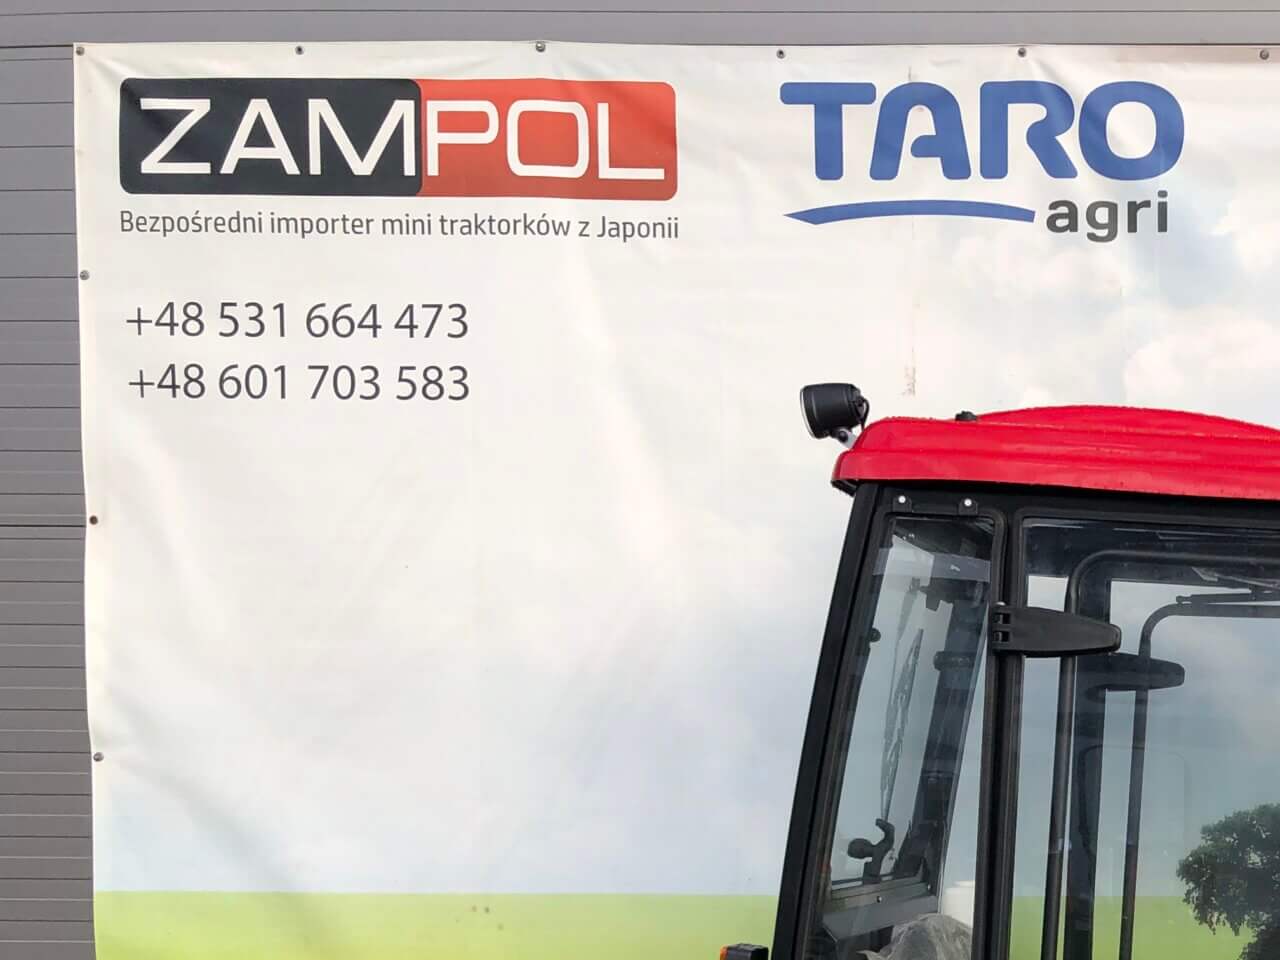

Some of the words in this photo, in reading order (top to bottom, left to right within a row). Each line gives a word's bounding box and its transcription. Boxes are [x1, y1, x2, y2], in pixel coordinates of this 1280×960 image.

[140, 97, 666, 180] ZAMPOL
[780, 80, 1185, 182] TARO
[119, 209, 263, 237] Bezpośredni
[270, 211, 374, 239] importer
[382, 212, 431, 235] mini
[439, 212, 571, 237] traktorków
[578, 221, 590, 238] z
[597, 214, 679, 243] Japonii
[1046, 190, 1169, 244] agri
[126, 301, 205, 338] +48
[218, 302, 286, 338] 531
[305, 302, 382, 338] 664
[393, 303, 469, 339] 473
[128, 363, 206, 399] +48
[217, 364, 286, 399] 601
[306, 365, 381, 401] 703
[396, 365, 470, 401] 583
